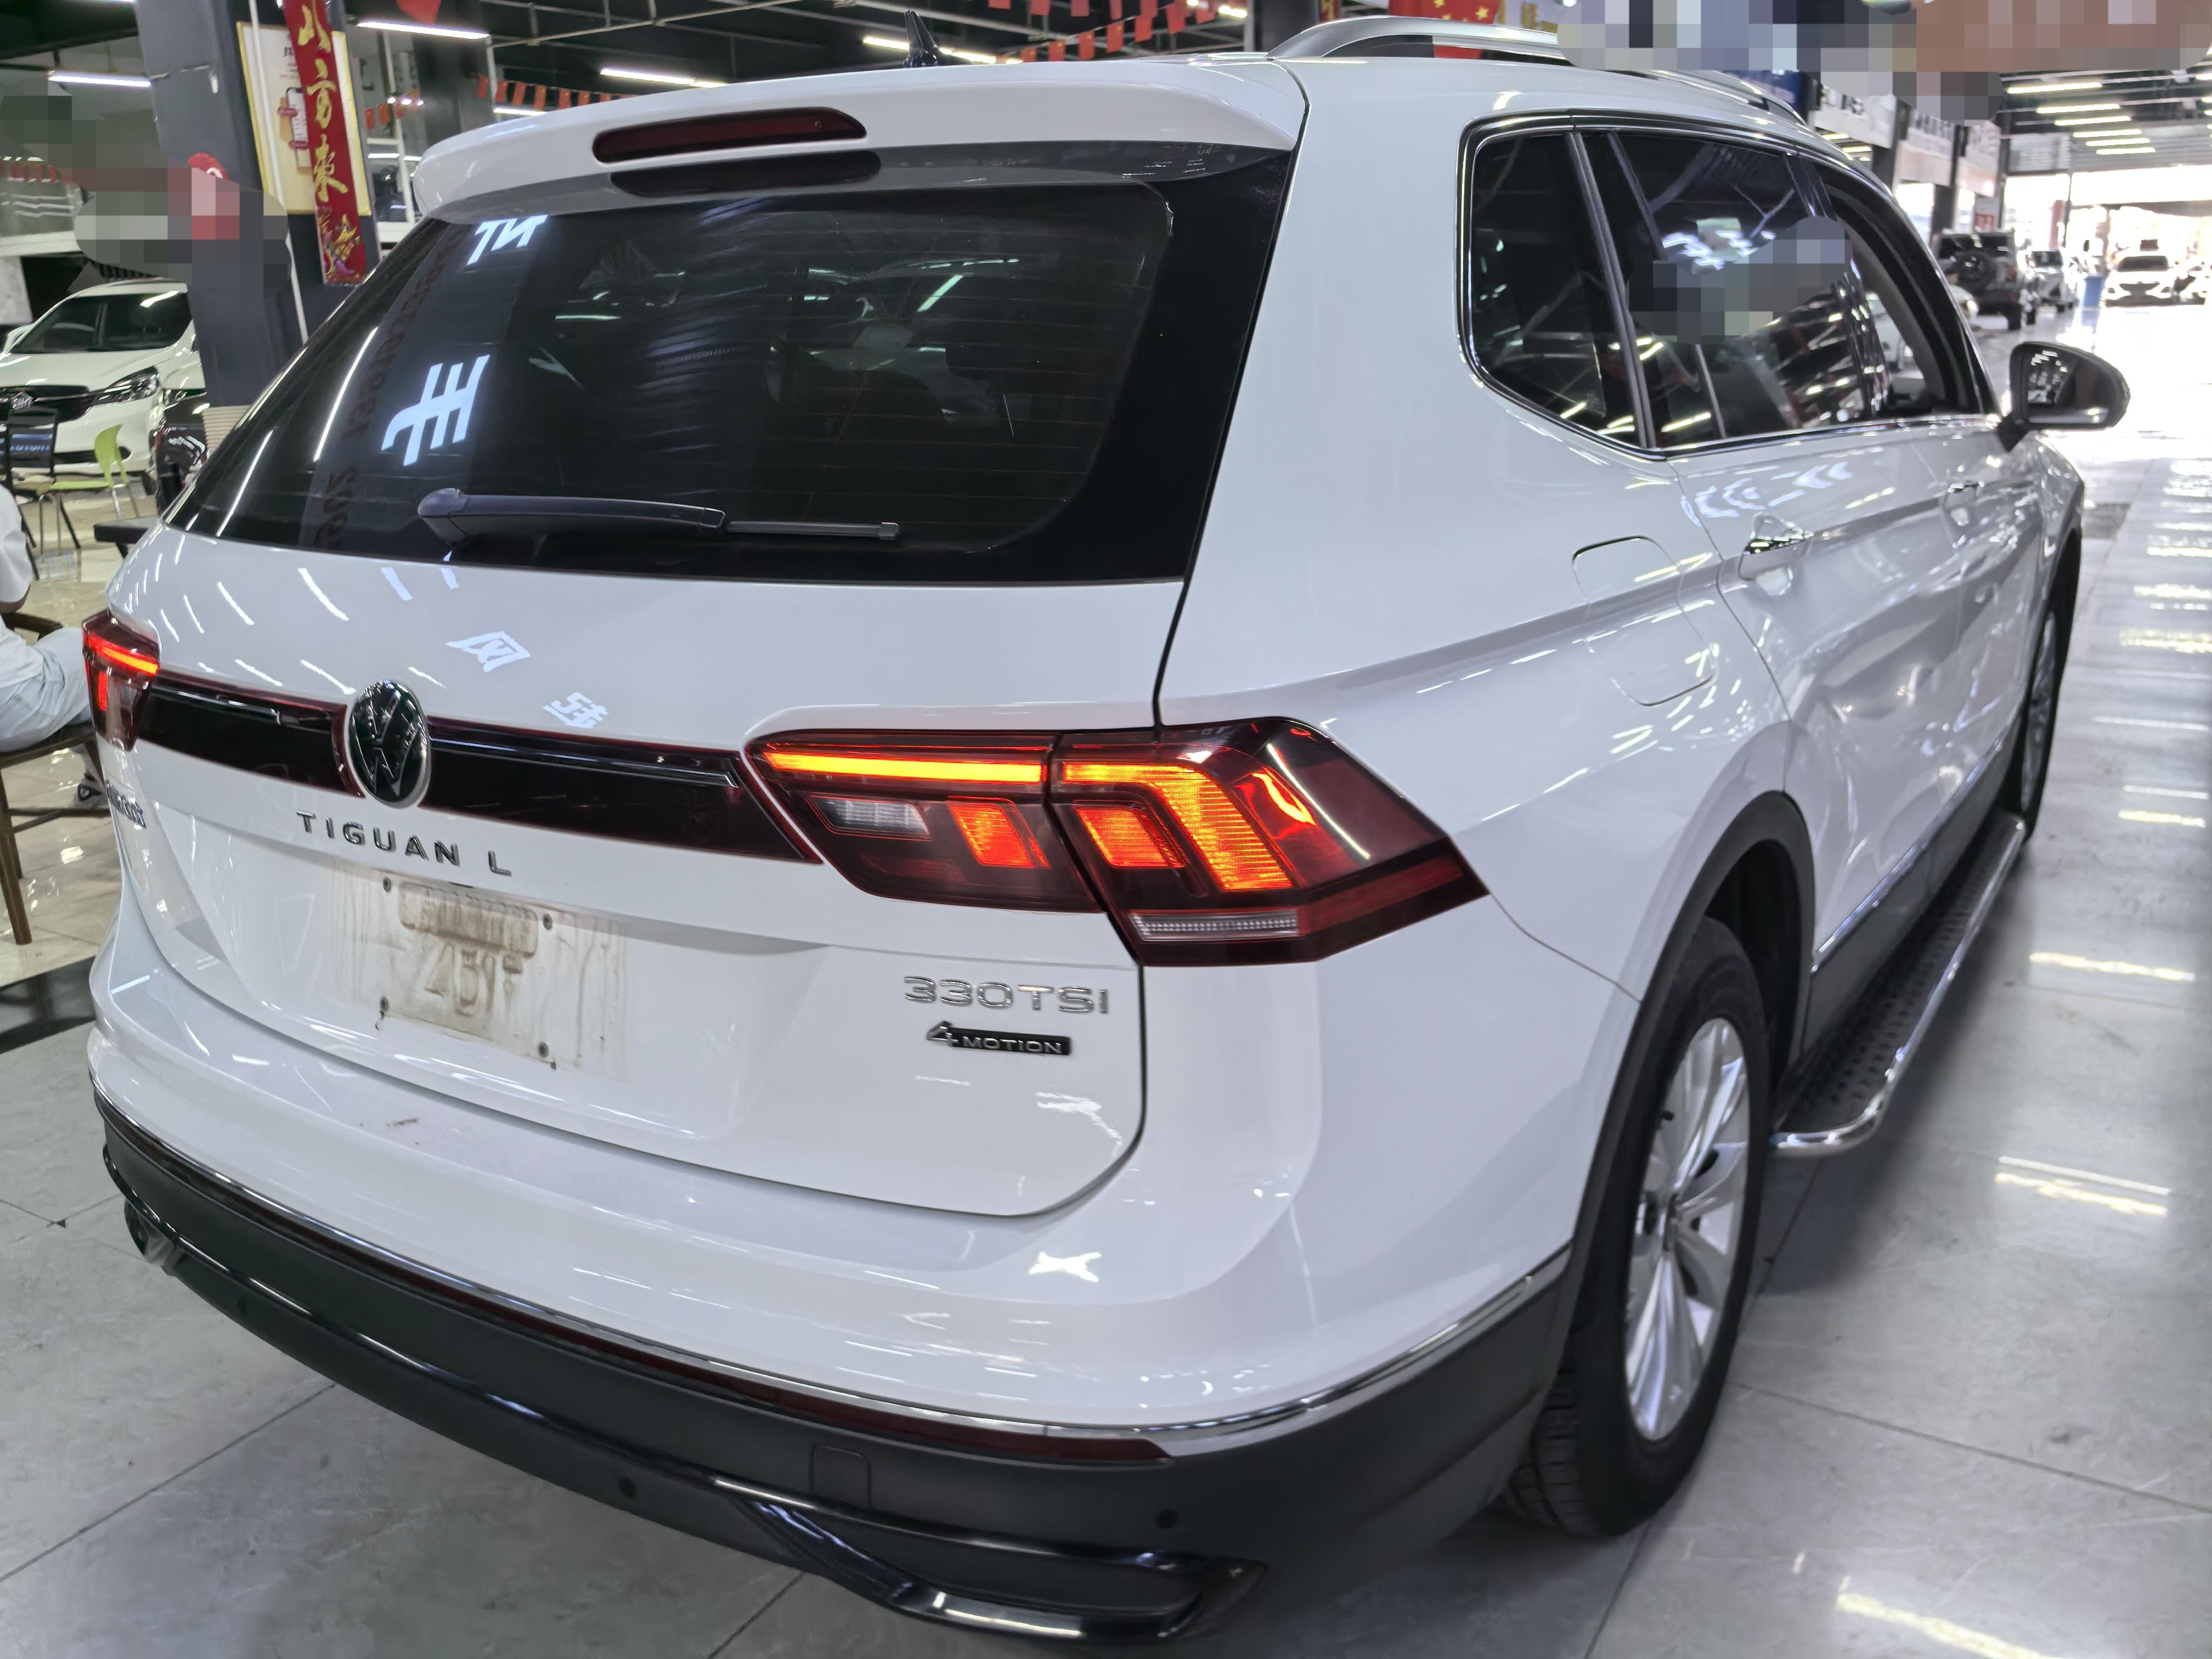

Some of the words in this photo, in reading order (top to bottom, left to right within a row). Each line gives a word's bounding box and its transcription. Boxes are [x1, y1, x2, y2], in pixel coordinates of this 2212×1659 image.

[296, 810, 460, 867] TIGUAN
[488, 850, 512, 876] L
[903, 976, 1109, 1013] 330TSI
[926, 1020, 1064, 1055] 4MOTION
